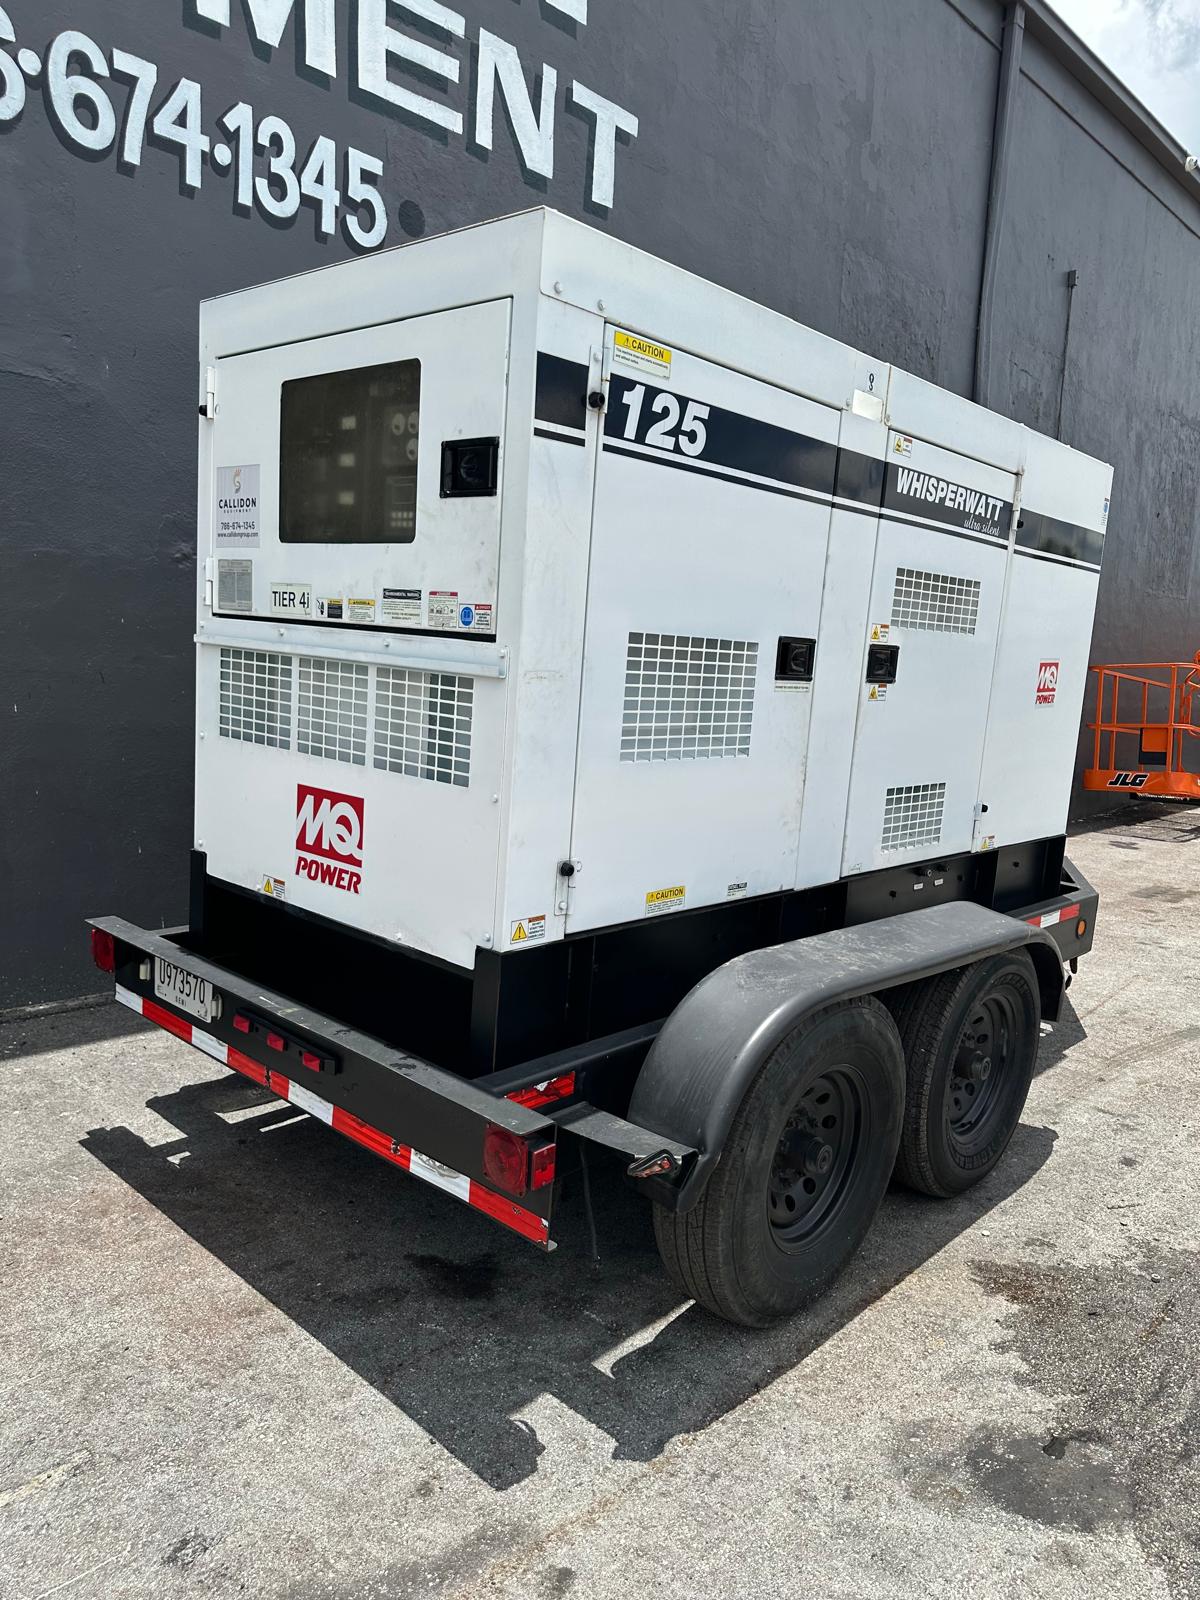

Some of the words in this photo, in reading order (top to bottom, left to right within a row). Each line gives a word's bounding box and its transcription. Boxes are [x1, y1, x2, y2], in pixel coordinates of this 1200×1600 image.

[631, 339, 665, 359] CAUTION
[622, 384, 711, 456] 125
[218, 497, 257, 509] CALLIDON
[897, 468, 1004, 521] WHISPERWATT
[963, 516, 982, 532] ultra
[982, 521, 1000, 536] silent
[271, 590, 296, 608] TIER
[1037, 664, 1058, 690] MQ
[1035, 693, 1055, 705] POWER
[1107, 772, 1149, 788] JLG
[296, 791, 363, 861] MQ
[295, 856, 362, 895] POWER
[655, 887, 684, 900] CAUTION
